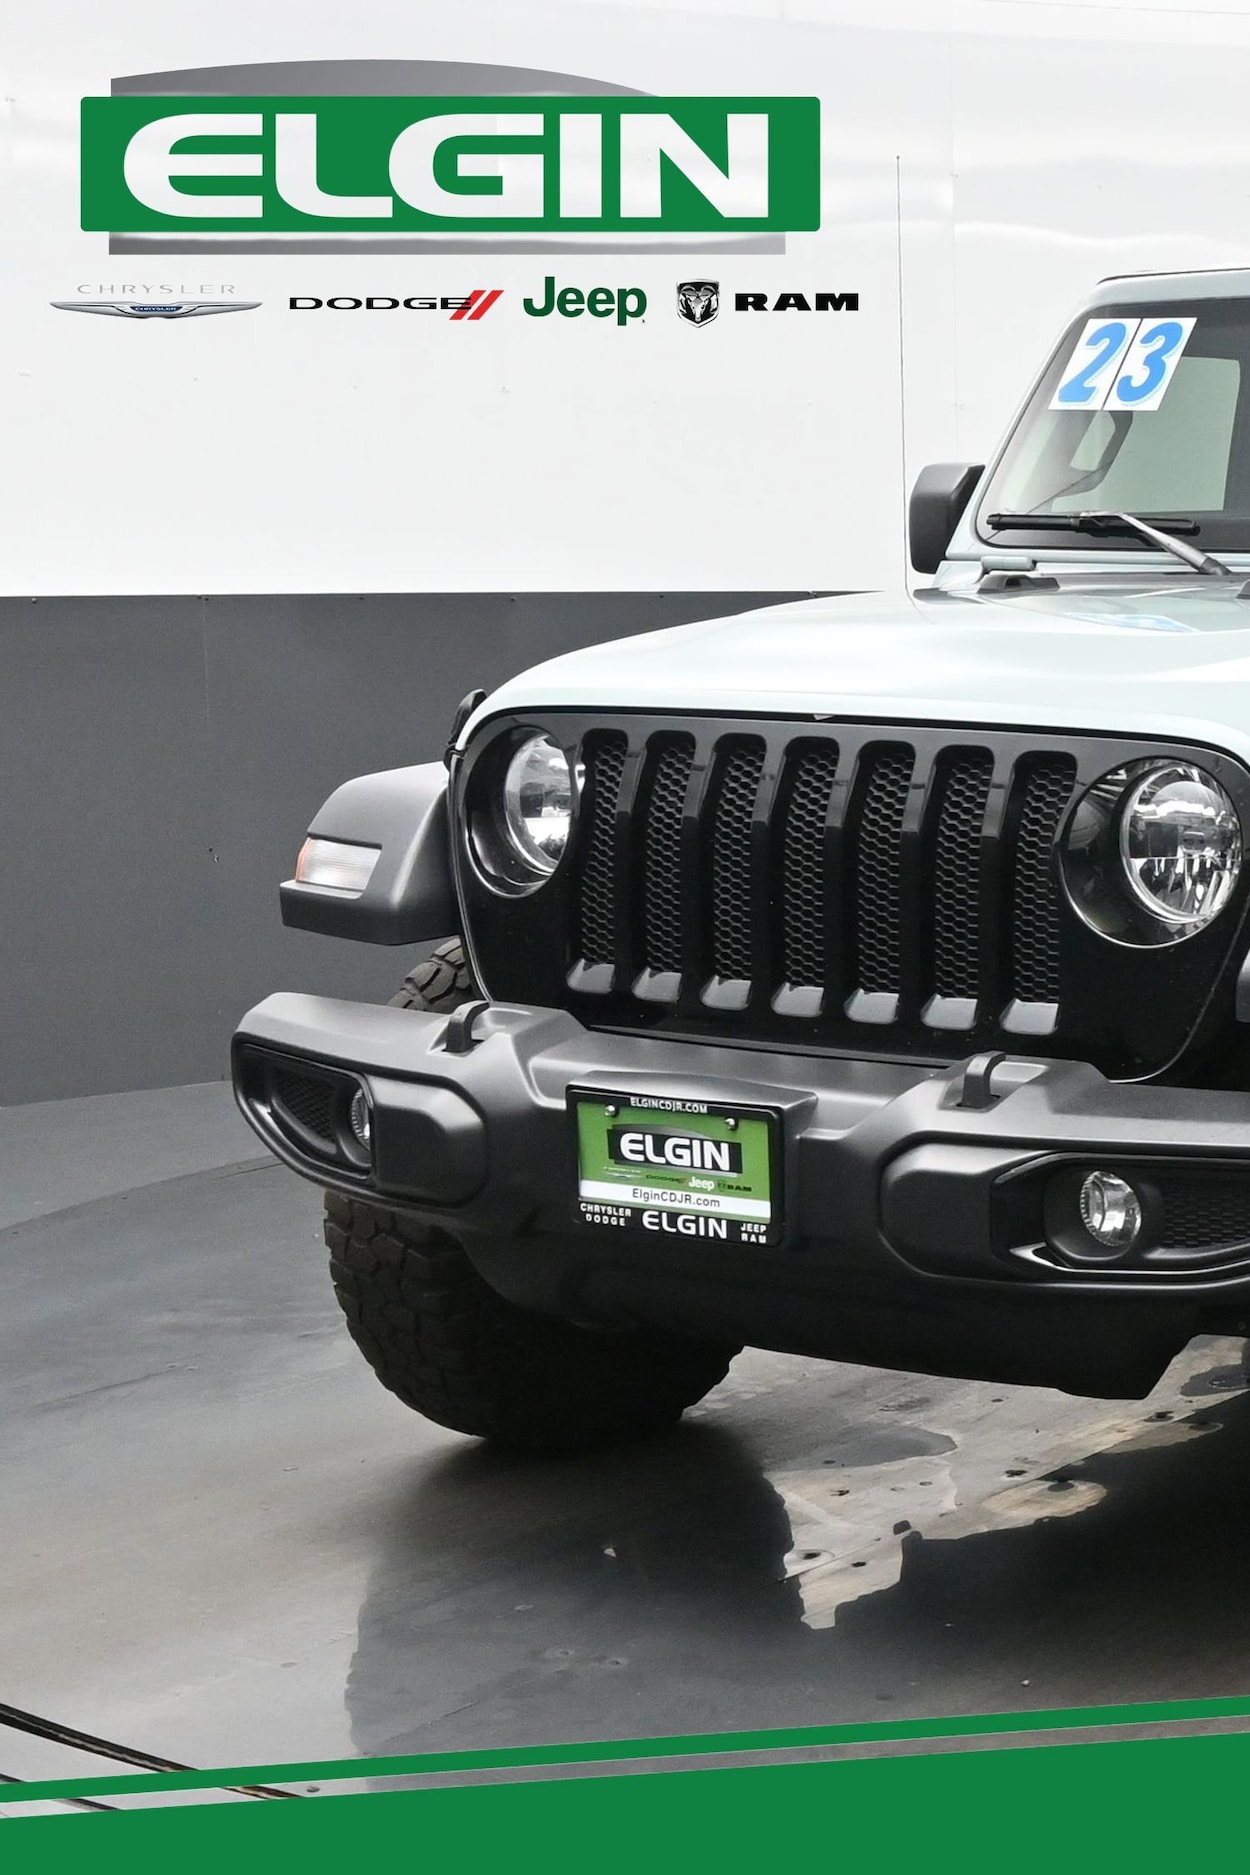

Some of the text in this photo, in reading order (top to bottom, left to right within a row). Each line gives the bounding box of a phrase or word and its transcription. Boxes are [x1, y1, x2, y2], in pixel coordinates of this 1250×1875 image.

[1058, 322, 1184, 404] 23
[630, 1096, 708, 1114] ELGINCDJR.COM
[620, 1132, 730, 1171] ELGIN
[688, 1176, 715, 1191] Jeep
[632, 1187, 720, 1207] ElginCDJR.com
[580, 1202, 631, 1217] CHRYSLER
[586, 1214, 625, 1226] DODGE
[642, 1210, 727, 1239] ELGIN
[740, 1222, 767, 1233] JEEP
[740, 1233, 767, 1244] RAM
